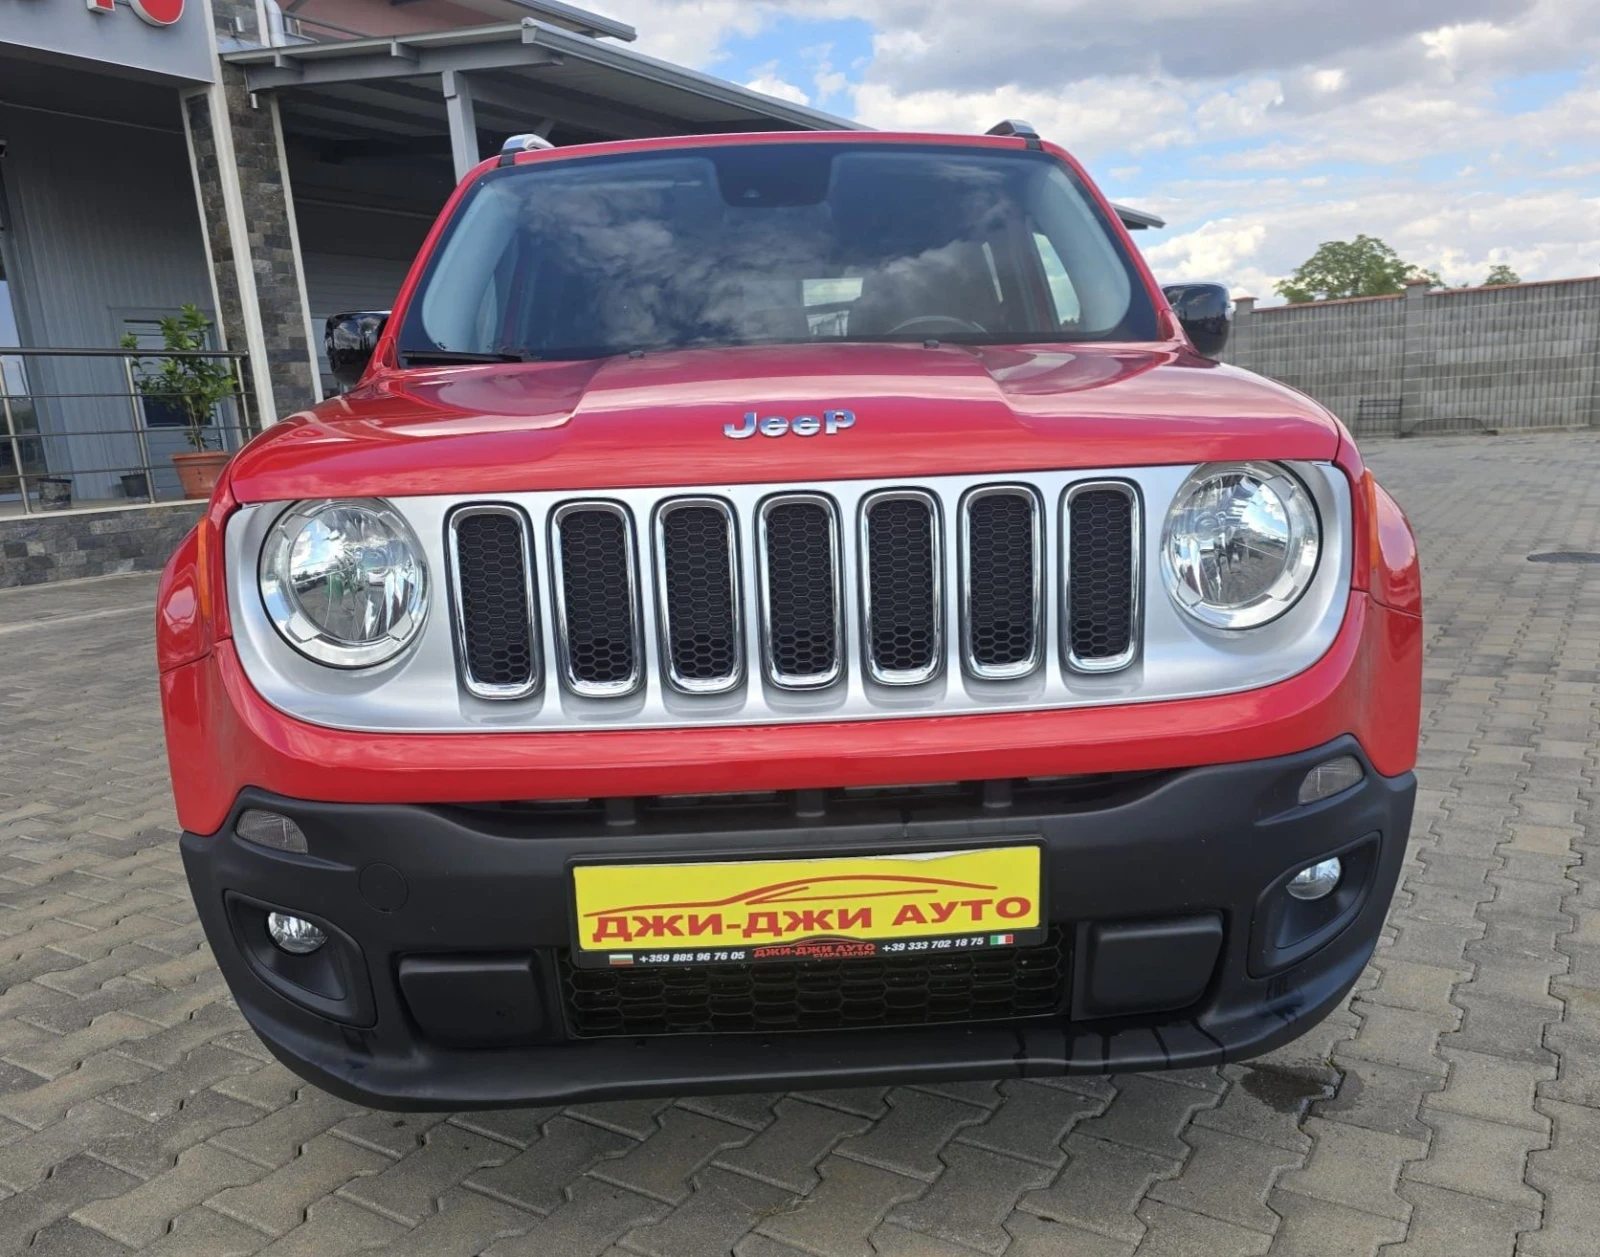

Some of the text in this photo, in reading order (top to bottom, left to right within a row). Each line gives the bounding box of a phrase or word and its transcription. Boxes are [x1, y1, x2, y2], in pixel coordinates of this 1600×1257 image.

[592, 896, 1032, 943] ДЖИ-ДЖИ АУТО
[754, 943, 876, 958] ДЖИ-ДЖИ АУТО
[882, 936, 985, 952] +39 333 702 18 75
[639, 951, 745, 963] +359 885 96 76 05
